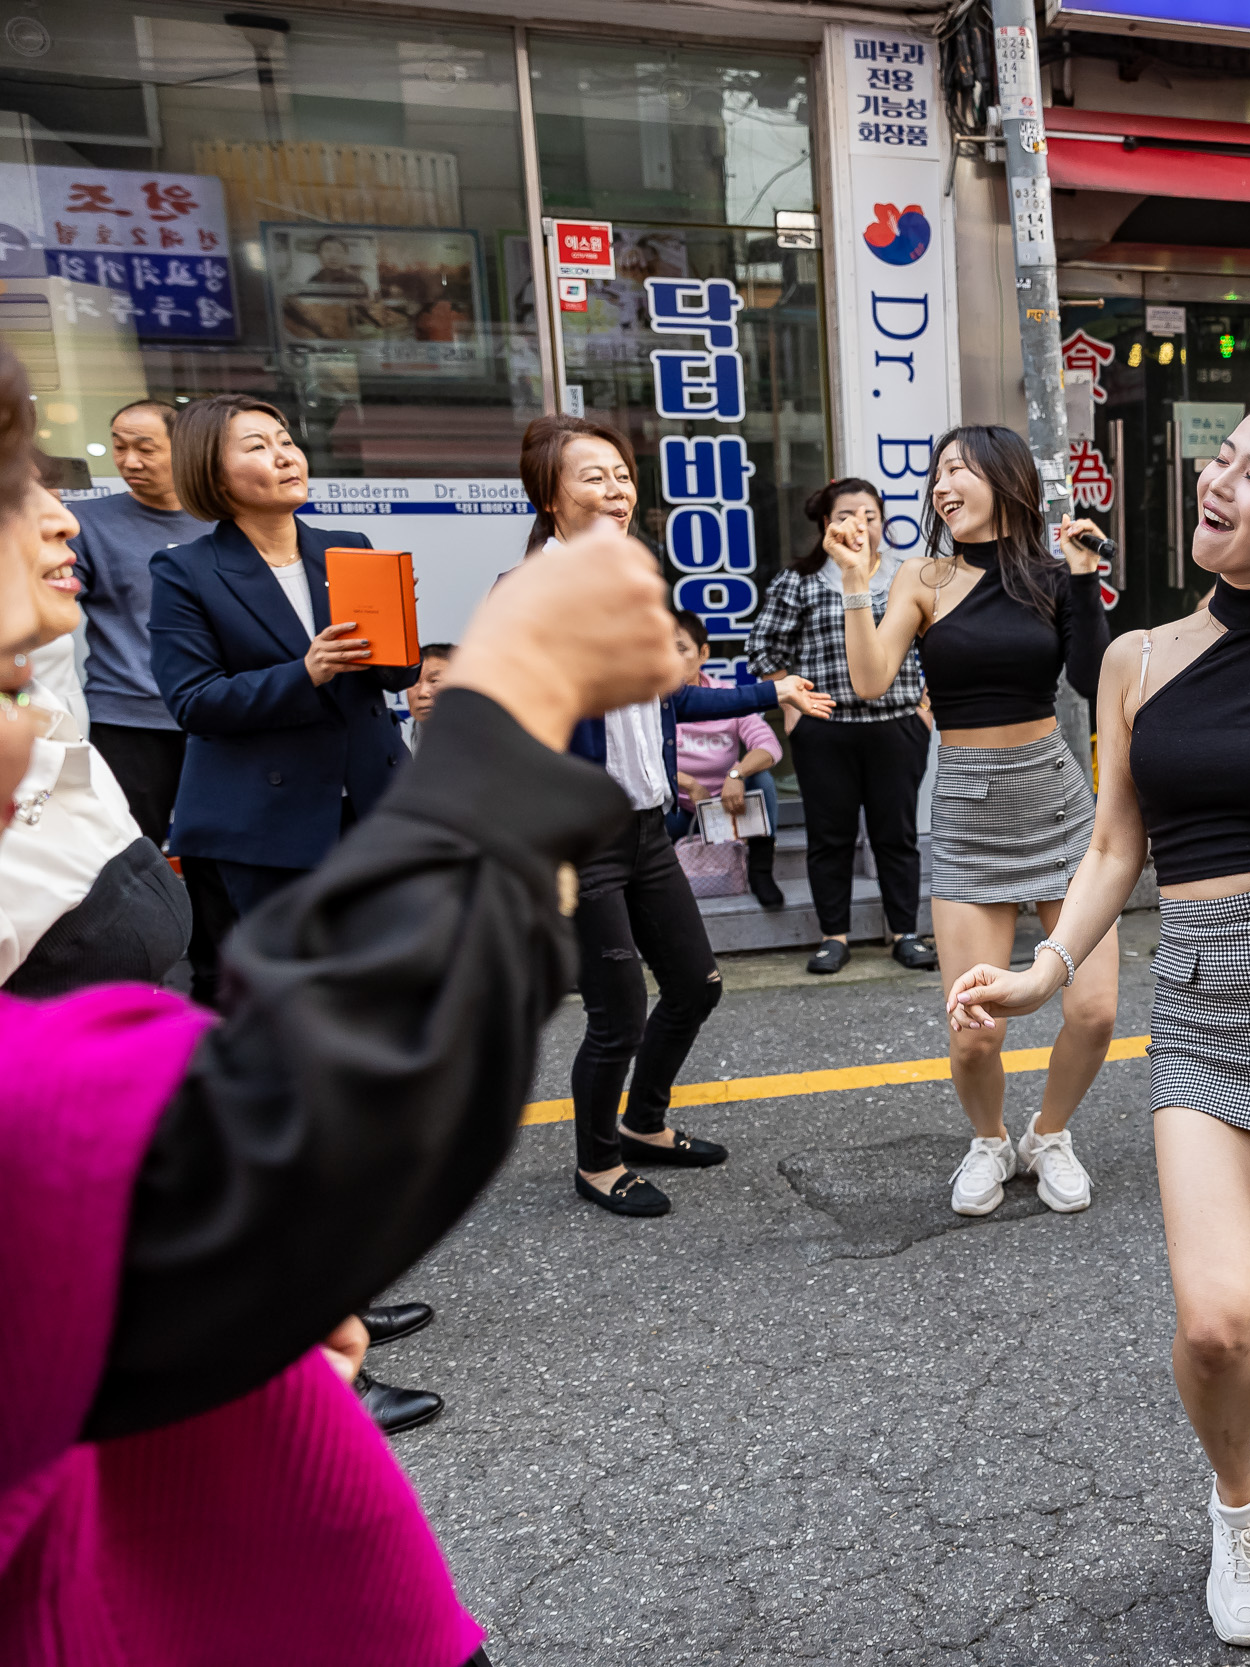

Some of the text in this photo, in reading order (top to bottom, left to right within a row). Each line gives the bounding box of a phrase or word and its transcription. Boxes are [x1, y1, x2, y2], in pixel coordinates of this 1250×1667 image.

[854, 38, 925, 65] 피부과
[867, 67, 914, 92] 전용
[857, 94, 927, 120] 기능성
[858, 122, 928, 147] 화장품
[564, 235, 603, 252] 에스원
[645, 278, 742, 421] 닥터
[872, 291, 928, 398] Dr.
[328, 483, 409, 499] Bioderm
[434, 484, 463, 499] Dr.
[661, 436, 756, 640] 바이오
